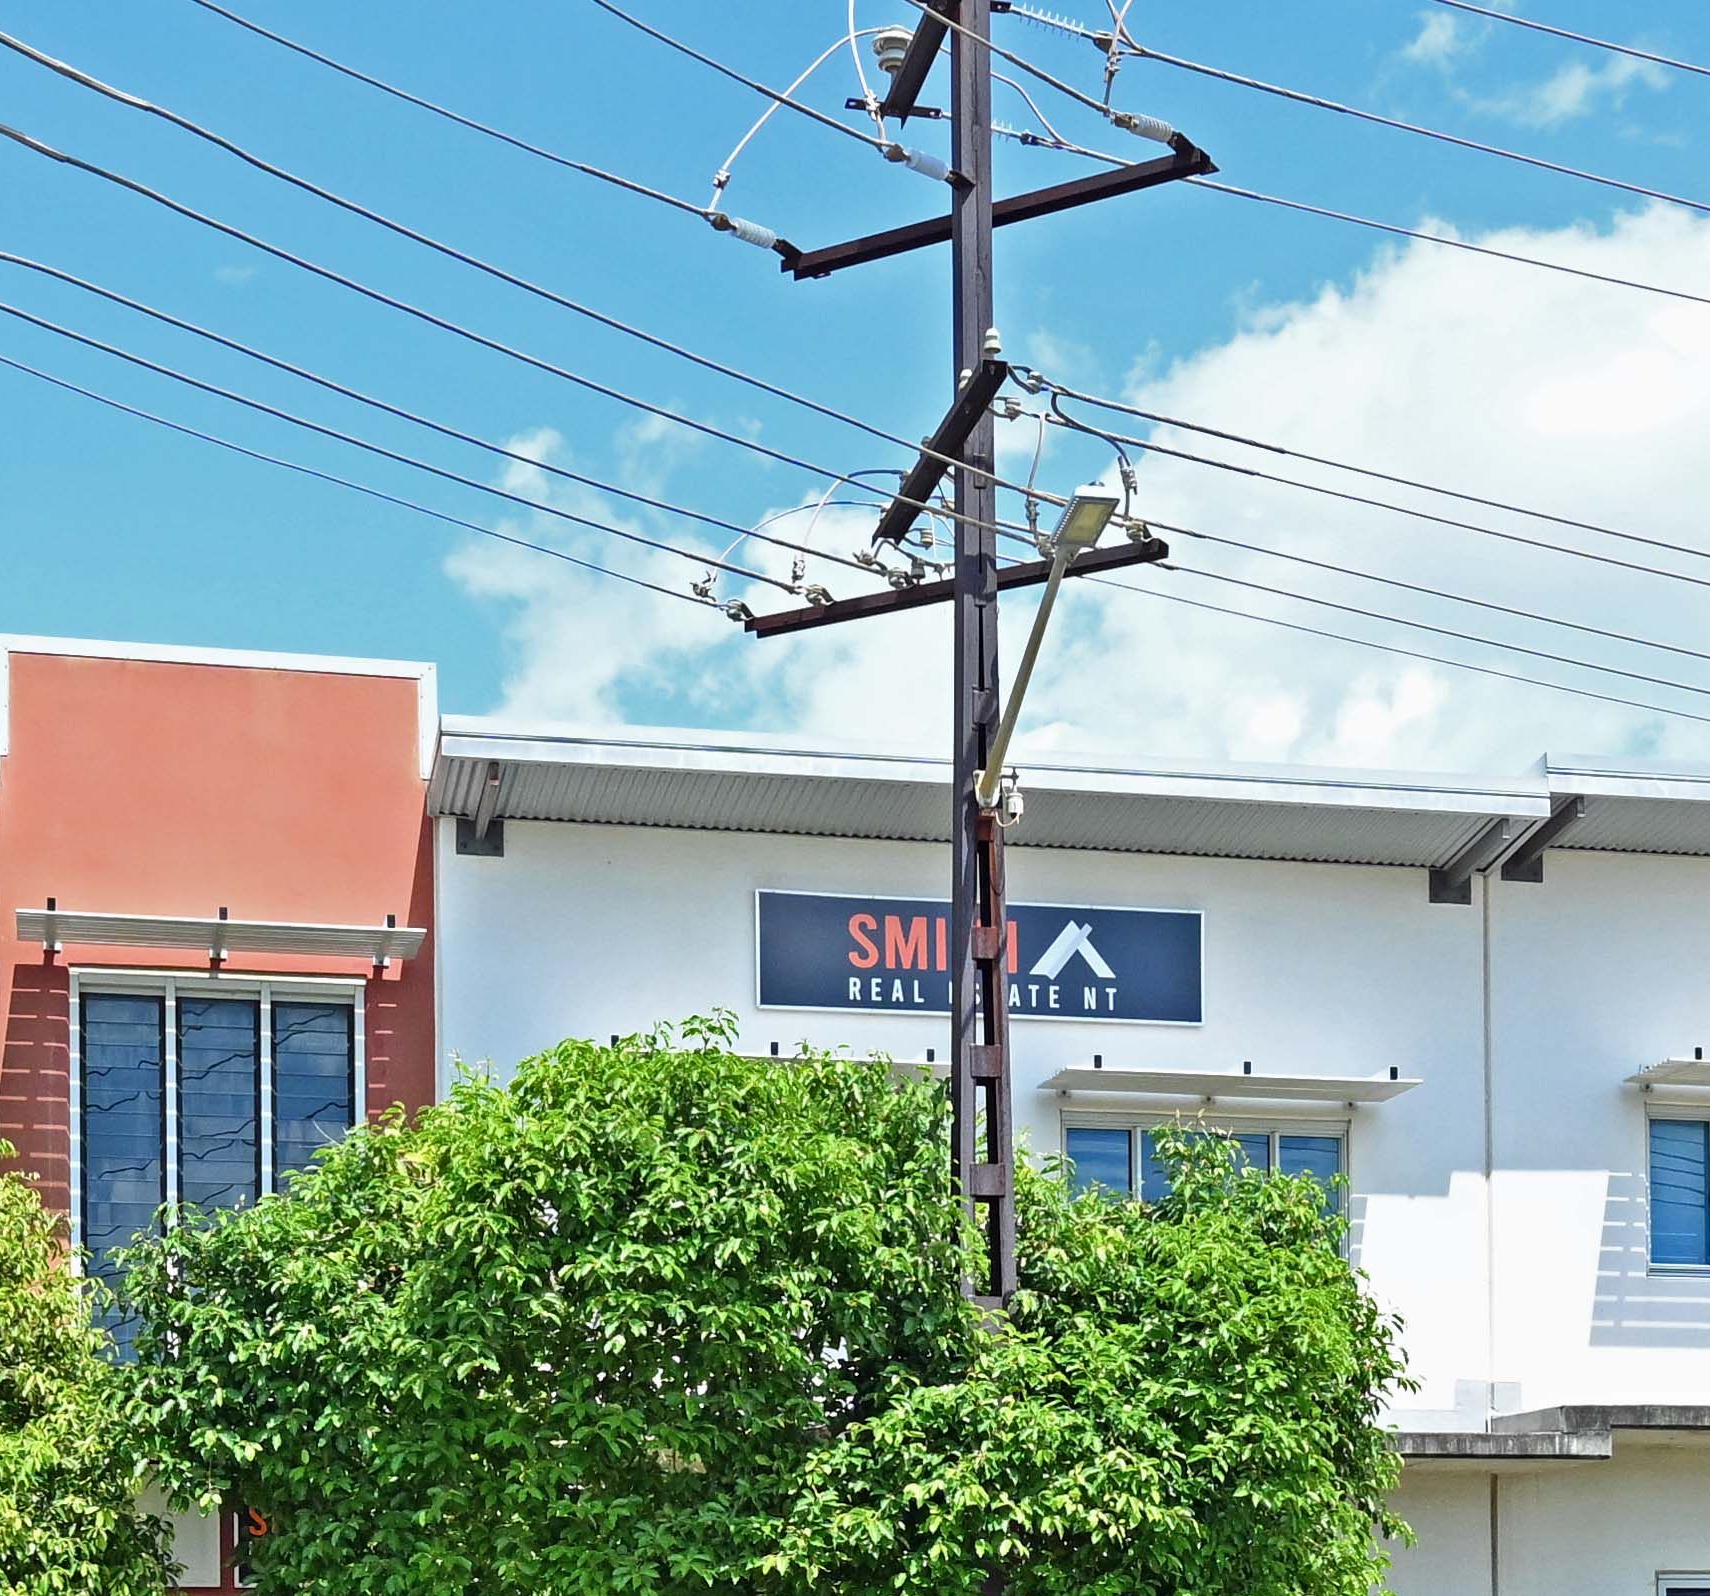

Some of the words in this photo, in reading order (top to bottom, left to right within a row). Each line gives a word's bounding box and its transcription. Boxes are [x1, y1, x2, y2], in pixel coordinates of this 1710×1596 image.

[848, 913, 1018, 974] SMI
[848, 977, 925, 1003] REAL
[948, 980, 1060, 1008] ATE
[1083, 987, 1118, 1011] NT
